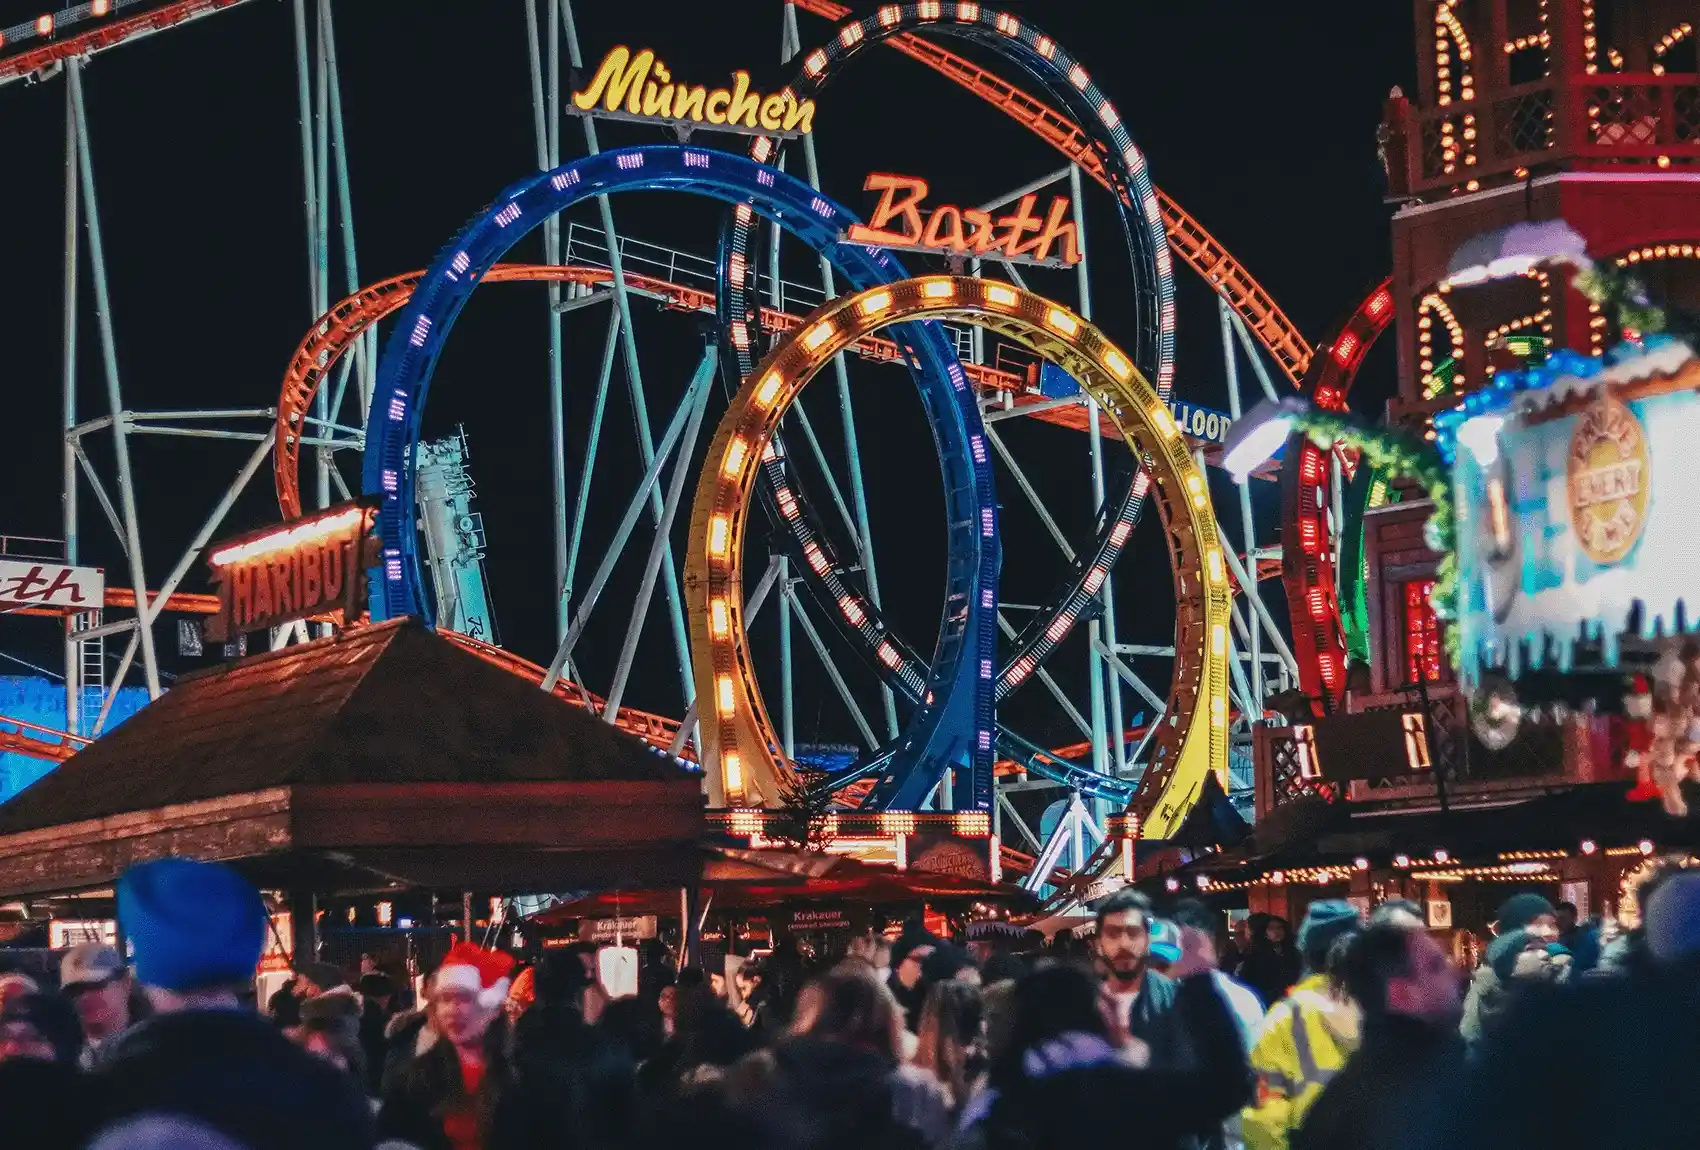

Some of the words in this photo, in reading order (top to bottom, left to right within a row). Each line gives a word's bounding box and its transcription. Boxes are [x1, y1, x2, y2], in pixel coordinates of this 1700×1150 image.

[574, 45, 815, 134] München
[849, 172, 1083, 265] Barth
[0, 566, 86, 602] th
[793, 910, 842, 921] Krakauer
